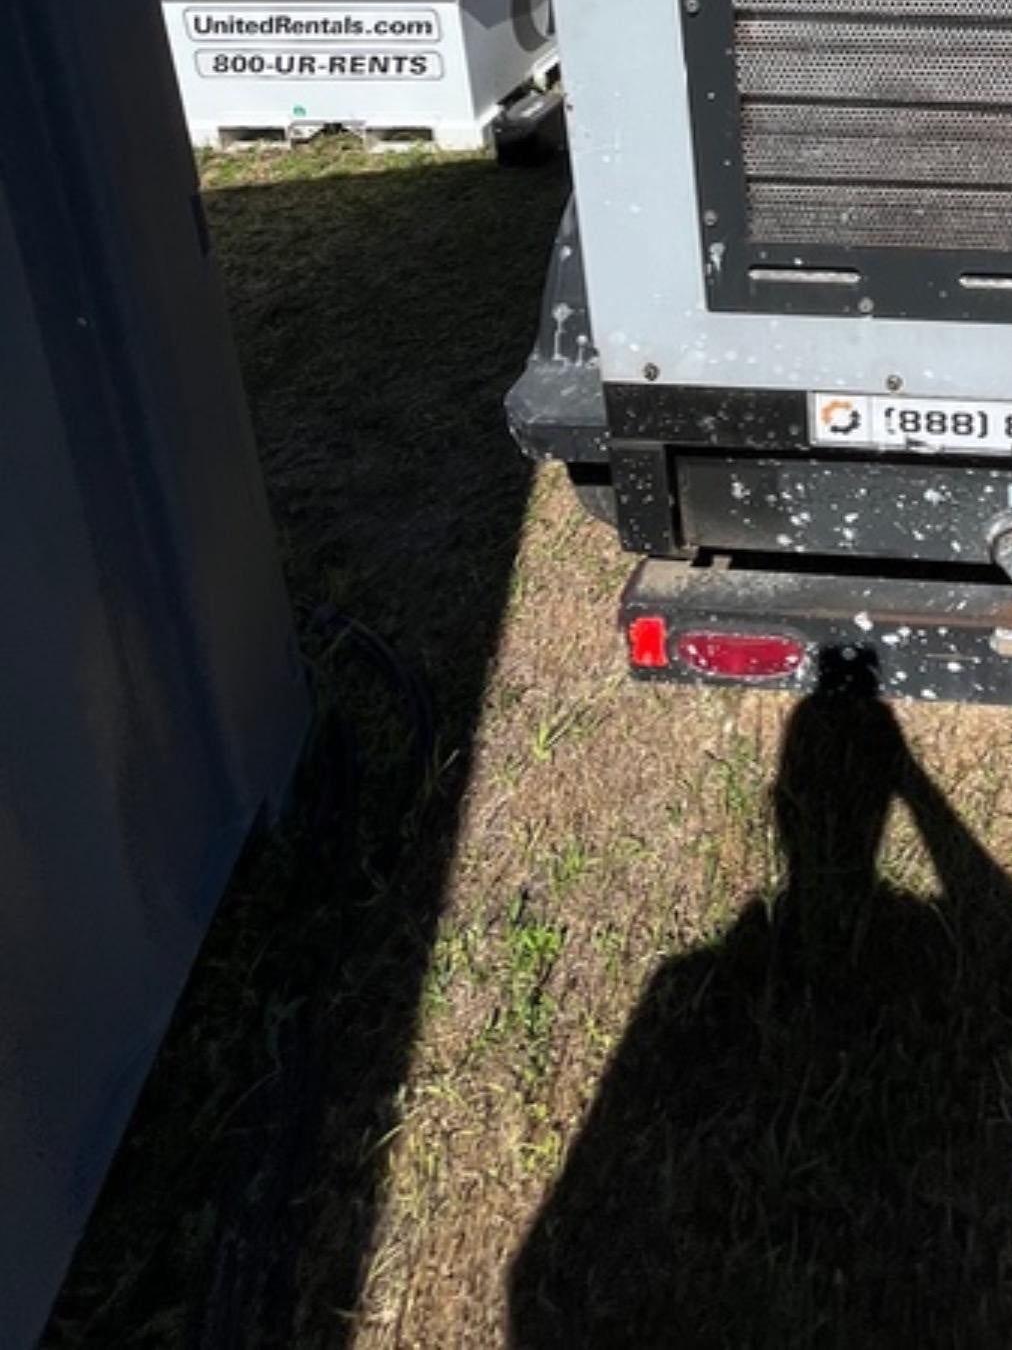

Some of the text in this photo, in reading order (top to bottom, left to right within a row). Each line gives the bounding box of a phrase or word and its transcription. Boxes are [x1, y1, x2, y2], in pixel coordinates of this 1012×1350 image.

[193, 15, 433, 35] UnitedRentals.com
[212, 54, 427, 74] 800-UR-RENTS
[884, 407, 988, 438] (888)
